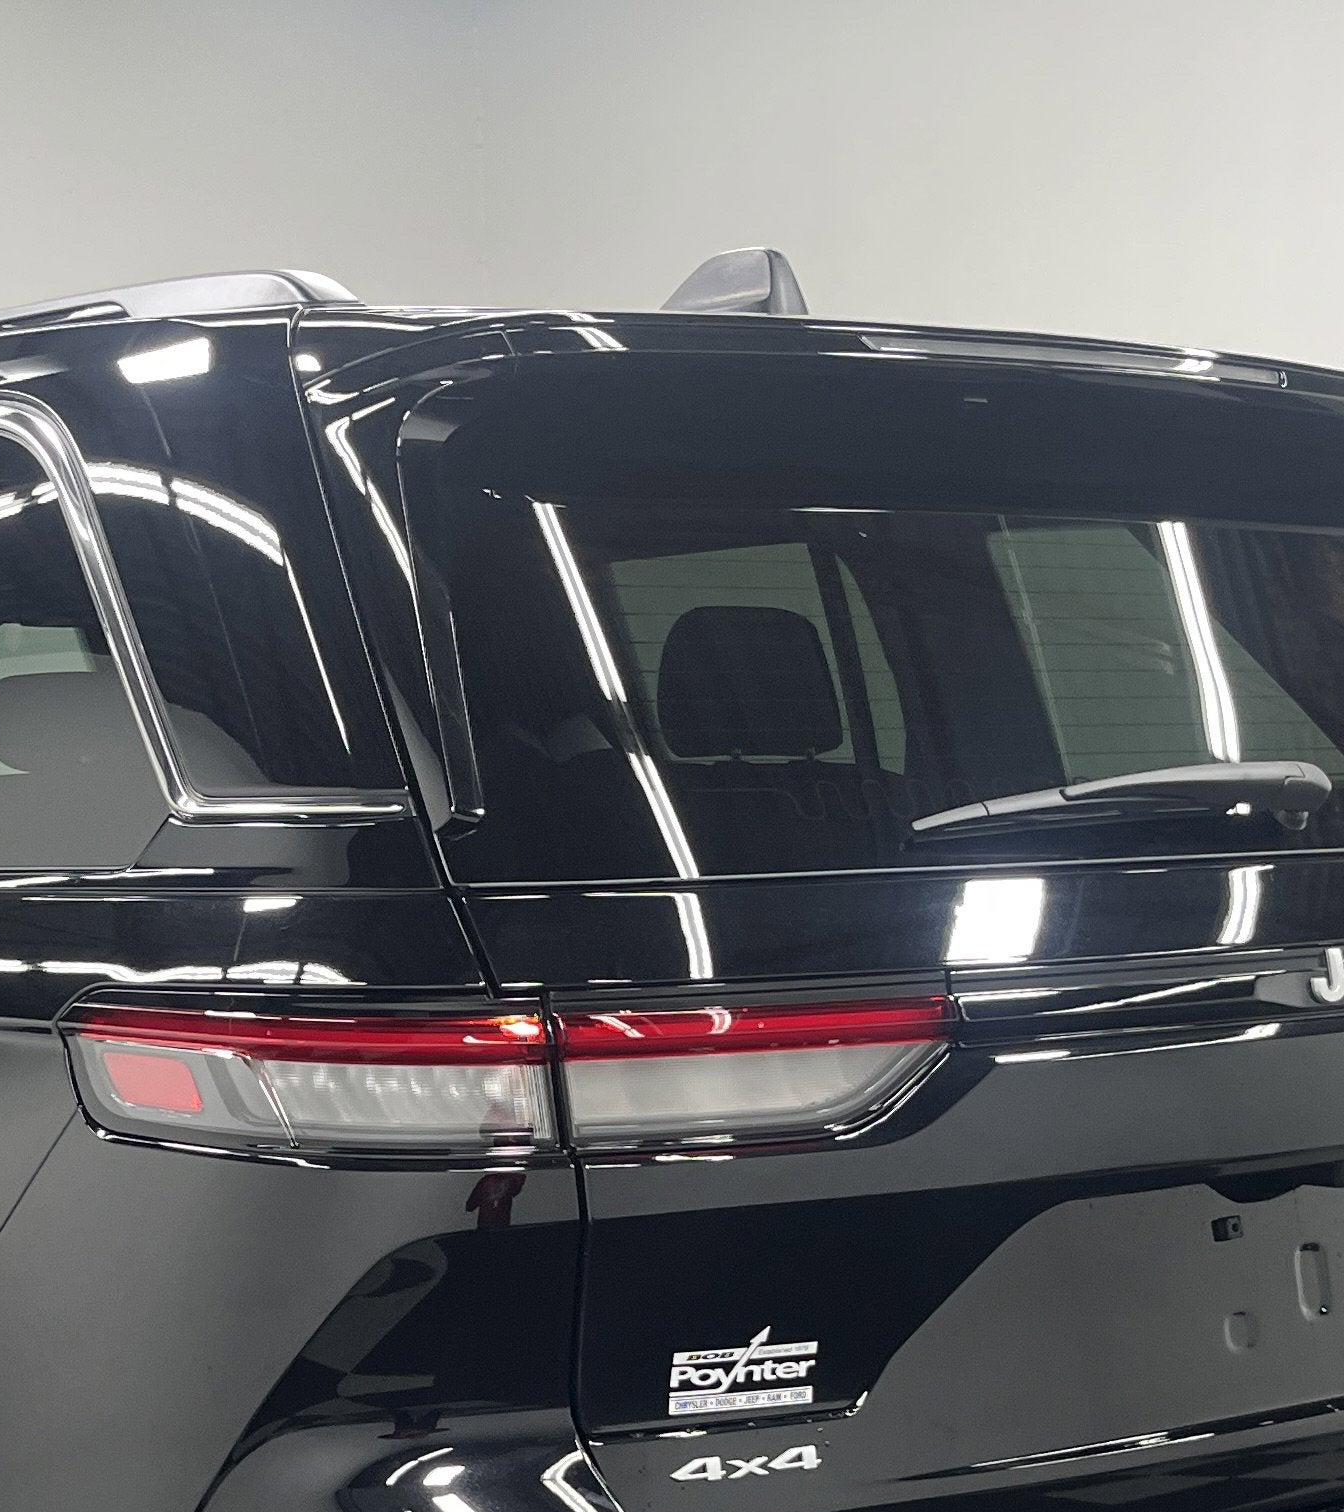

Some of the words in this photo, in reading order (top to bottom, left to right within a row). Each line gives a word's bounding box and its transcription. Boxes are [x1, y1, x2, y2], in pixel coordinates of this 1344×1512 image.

[686, 1351, 735, 1361] BOB
[669, 1358, 816, 1394] Poynter
[669, 1444, 822, 1481] 4x4
